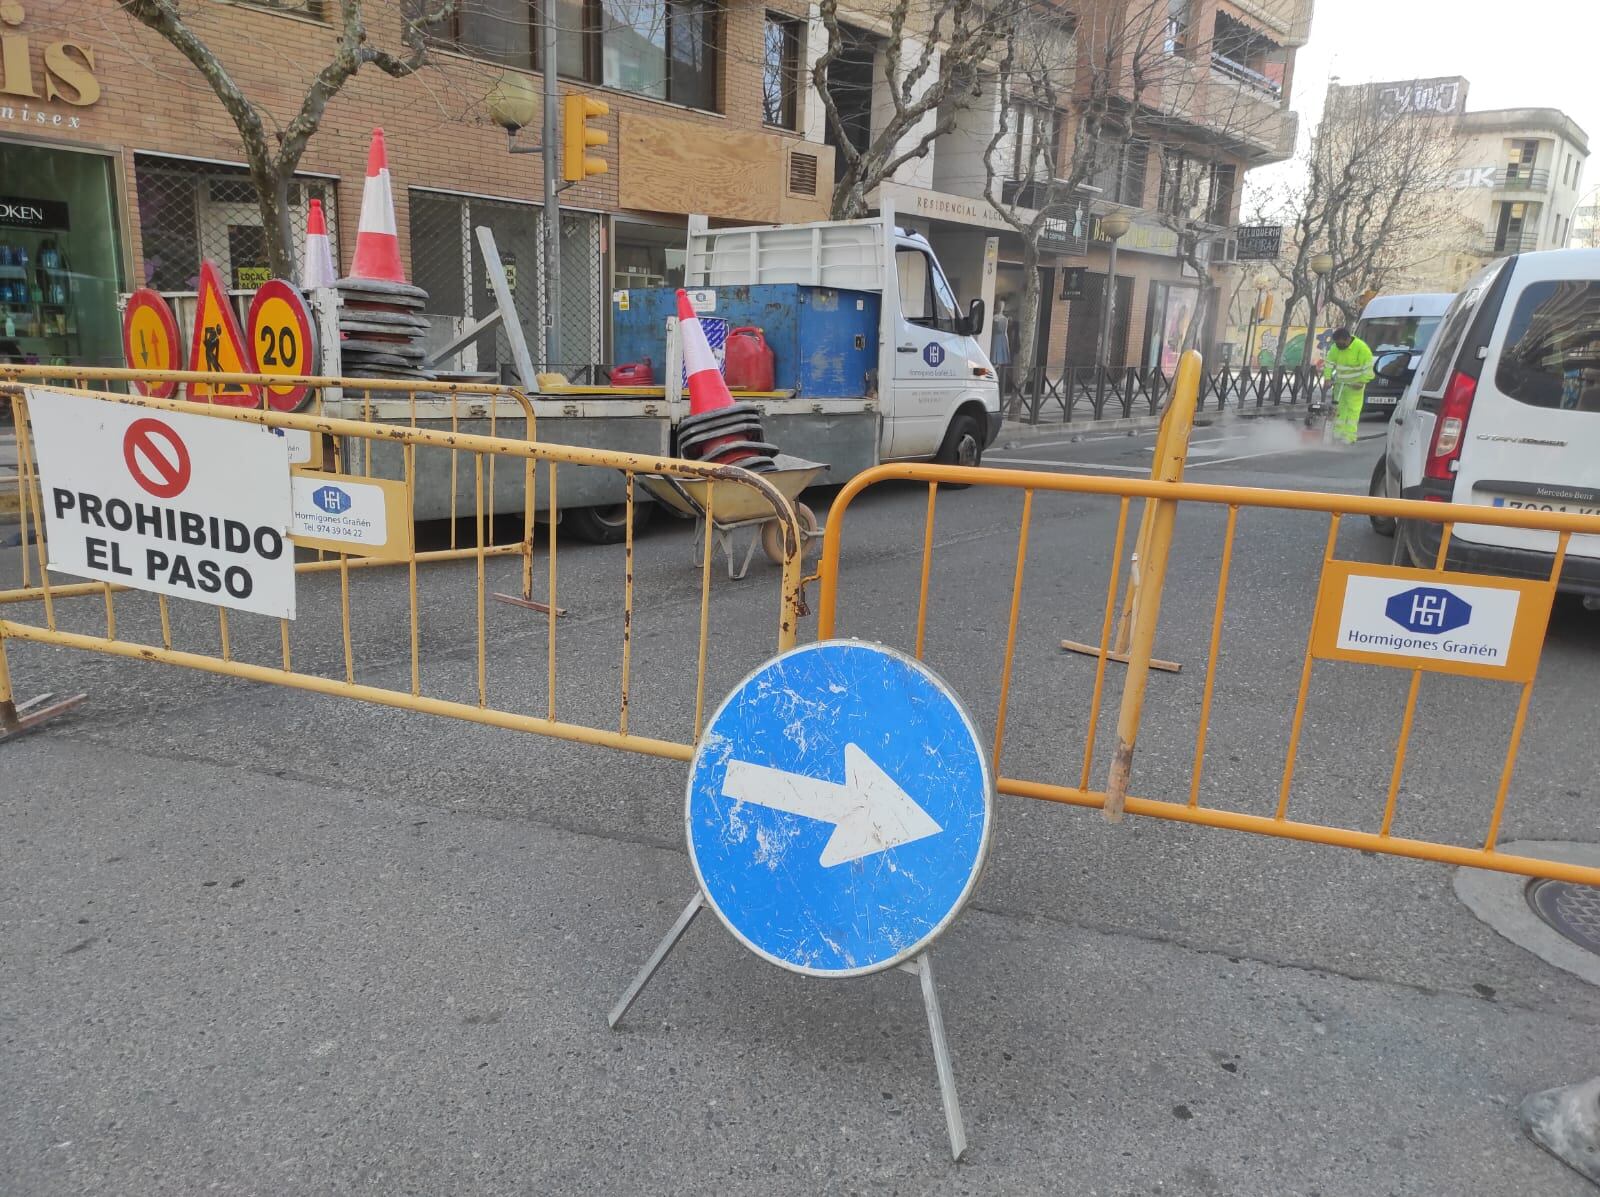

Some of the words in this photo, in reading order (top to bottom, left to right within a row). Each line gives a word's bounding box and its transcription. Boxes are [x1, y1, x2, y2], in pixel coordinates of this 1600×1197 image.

[917, 196, 977, 217] RESIDENCIAL
[260, 325, 297, 368] 20
[53, 487, 283, 561] PROHIBIDO
[294, 511, 341, 524] Hormigones
[342, 516, 371, 528] Grañén
[316, 524, 330, 534] 974
[332, 527, 341, 535] 39
[342, 528, 352, 536] 04
[353, 529, 363, 538] 22
[86, 536, 133, 576] EL
[146, 548, 254, 600] PASO
[1348, 630, 1439, 650] Hormigones
[1442, 639, 1498, 657] Grañén
